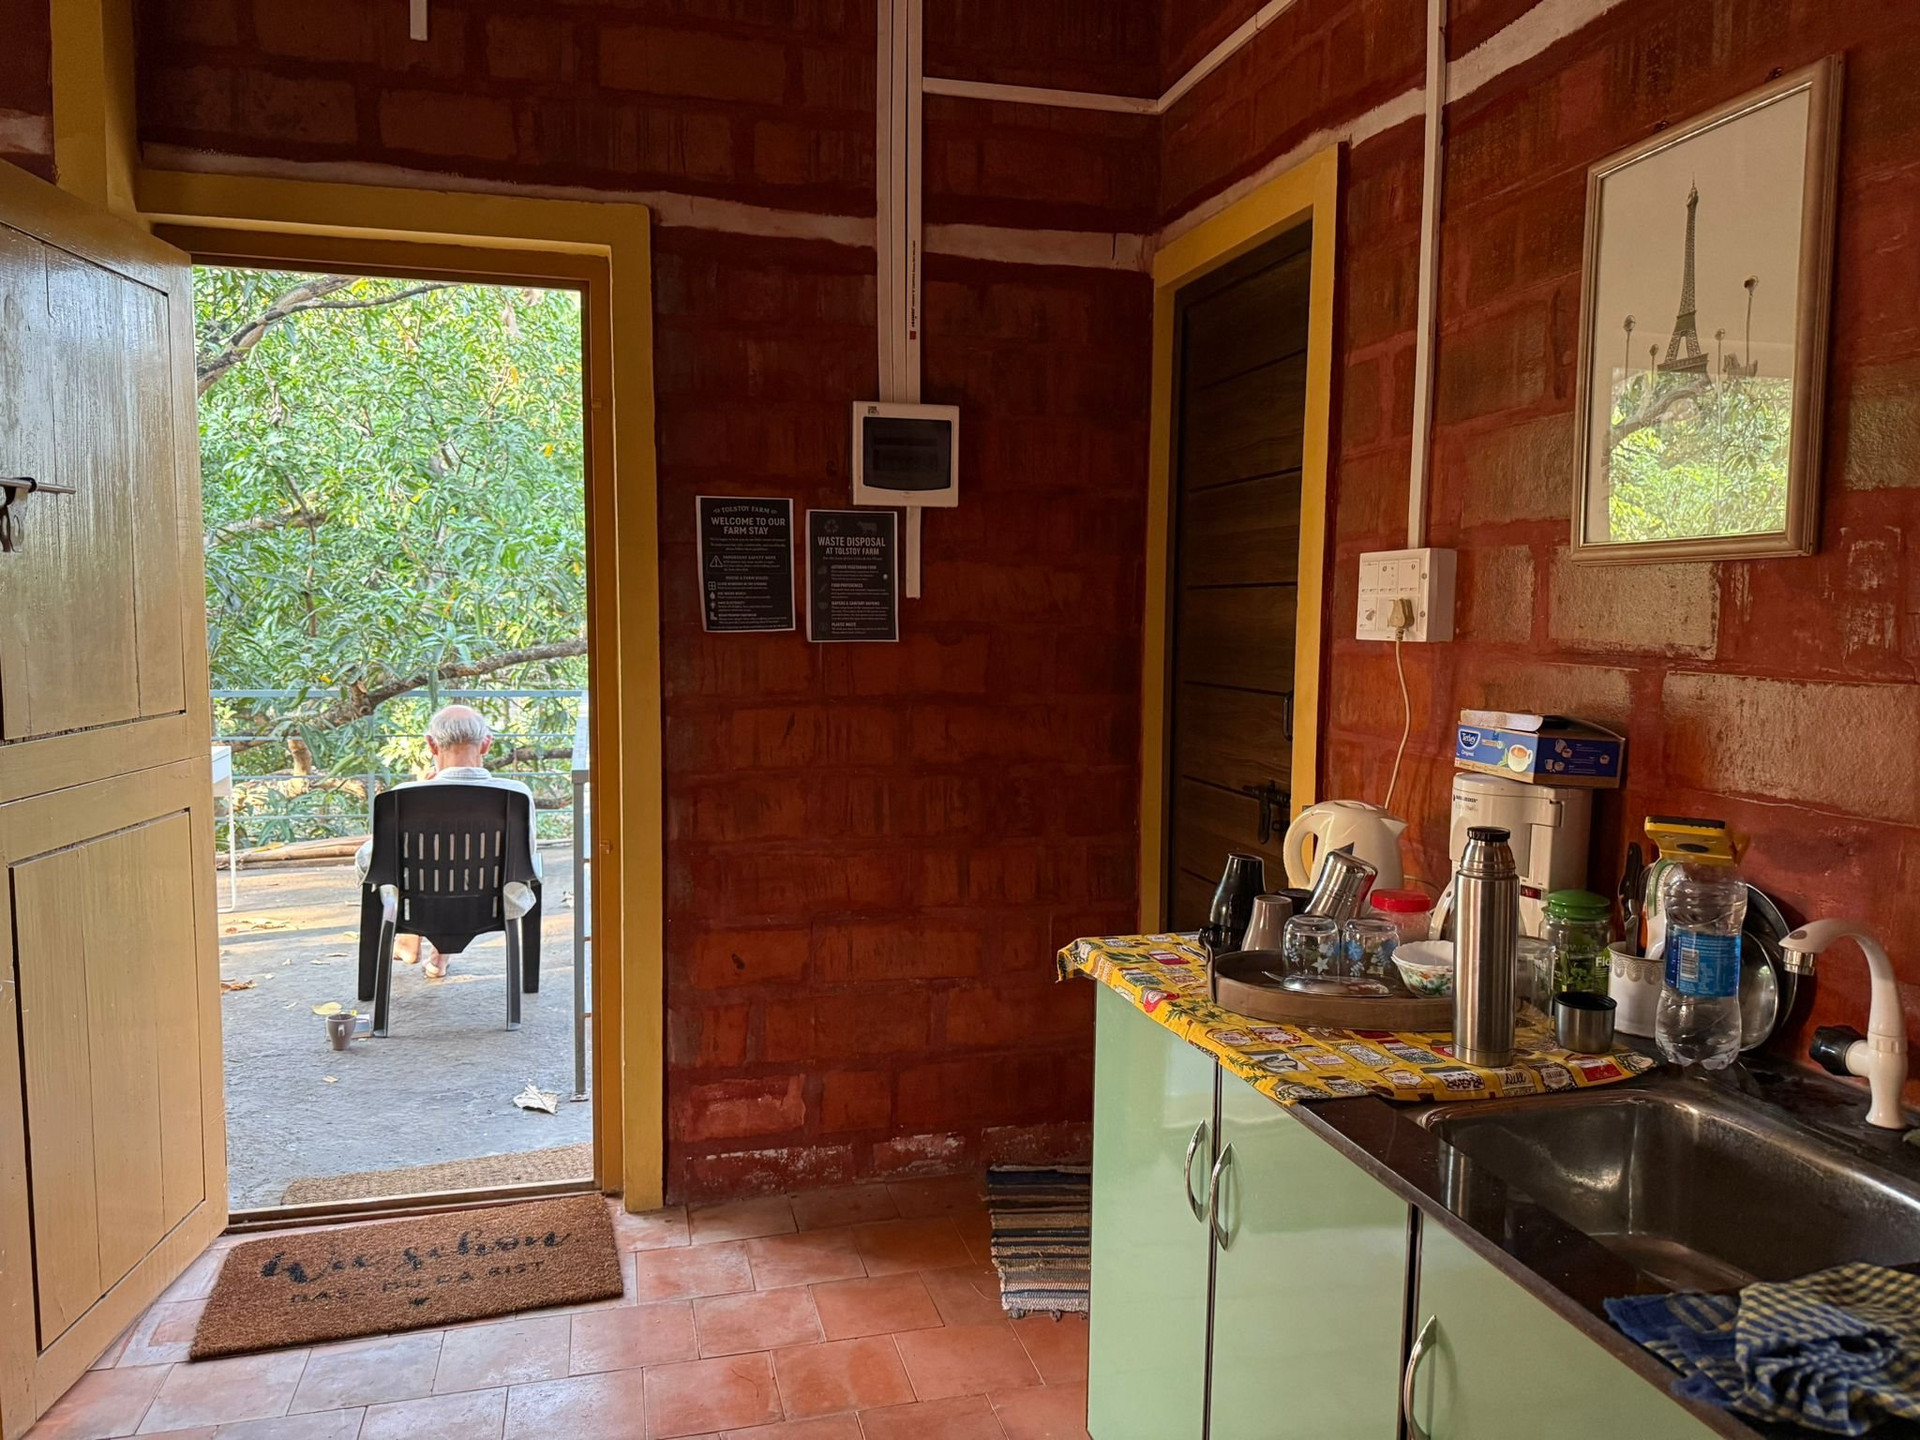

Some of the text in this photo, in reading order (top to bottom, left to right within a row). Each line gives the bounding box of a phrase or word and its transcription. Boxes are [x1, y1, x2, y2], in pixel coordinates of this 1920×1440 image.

[721, 505, 770, 514] TOLSTOY FARM
[710, 517, 786, 526] WELCOME TO OUR
[723, 526, 769, 535] FARM STAY
[817, 536, 886, 547] WASTE DISPOSAL
[825, 547, 880, 555] AT TOLSTOY FARM
[1595, 956, 1611, 967] Flo
